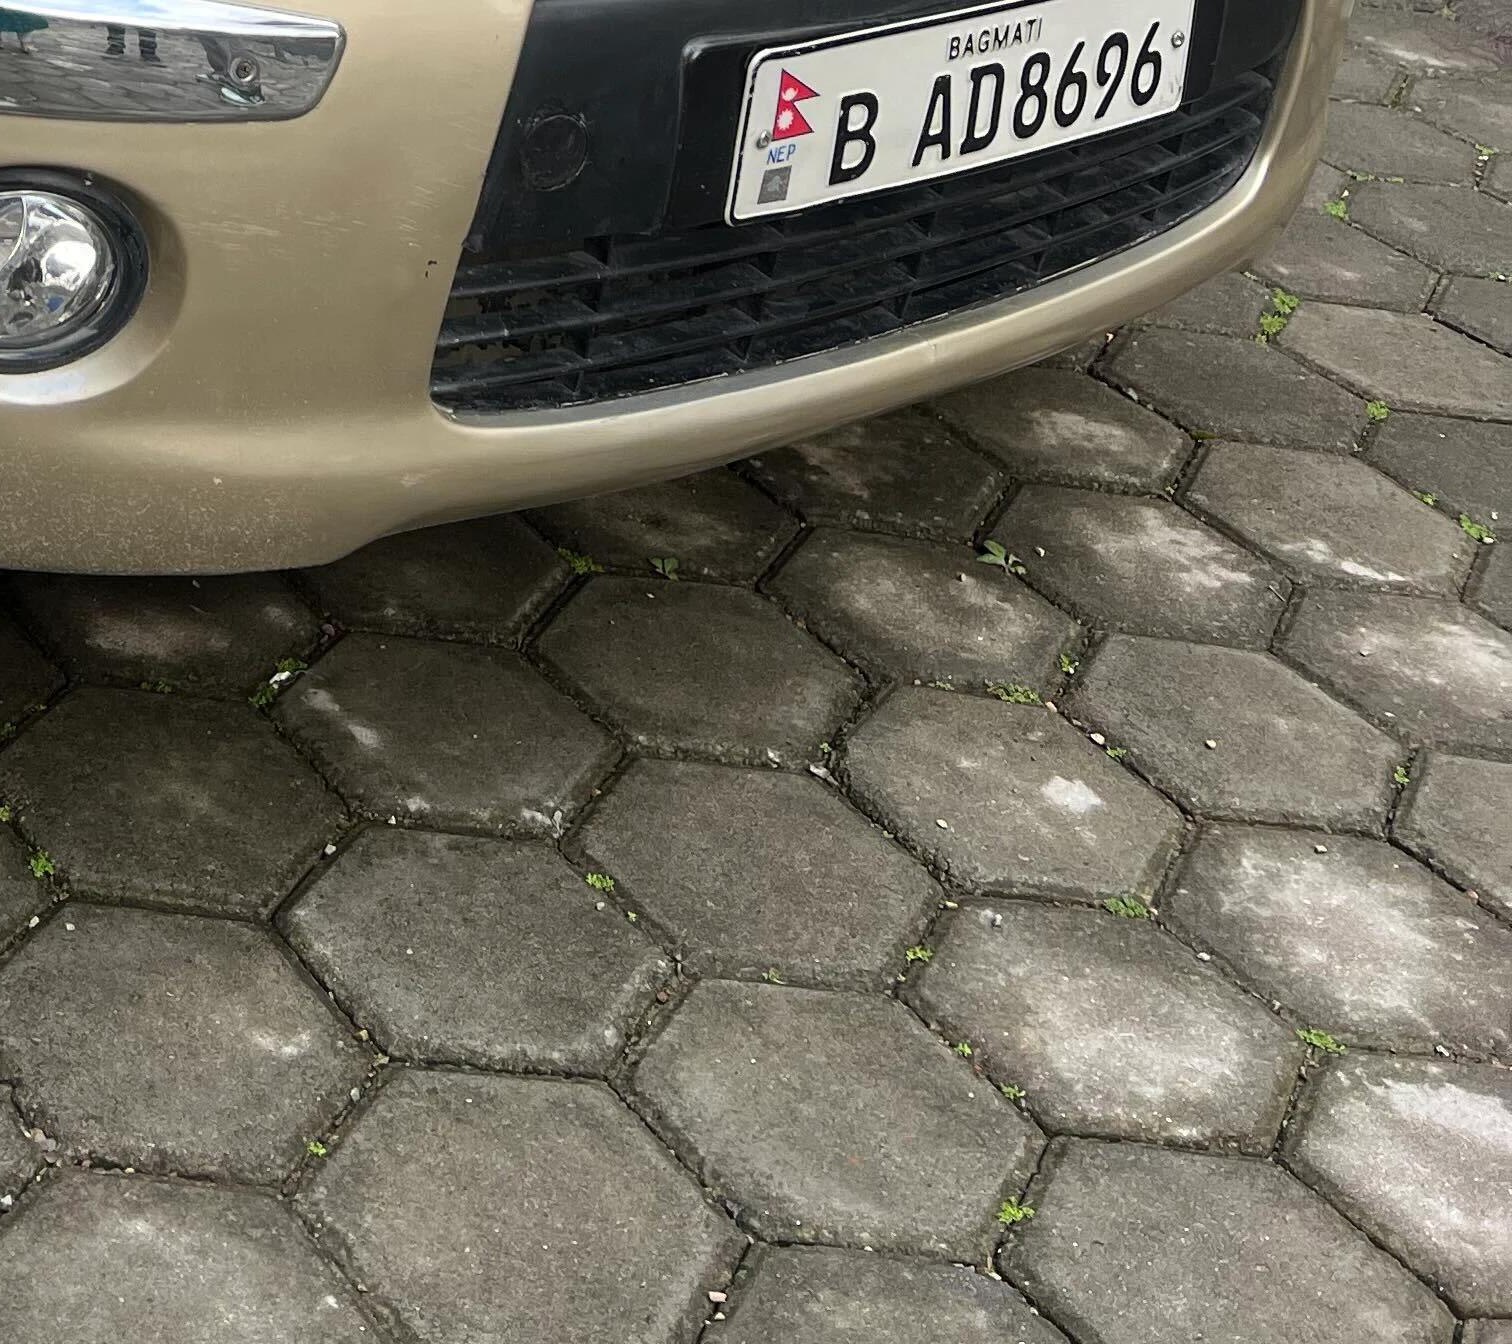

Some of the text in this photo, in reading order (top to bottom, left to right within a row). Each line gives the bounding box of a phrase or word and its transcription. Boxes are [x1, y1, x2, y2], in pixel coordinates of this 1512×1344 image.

[947, 17, 1043, 61] BAGMATI
[829, 21, 1162, 187] B AD8696
[766, 143, 797, 166] NEP
